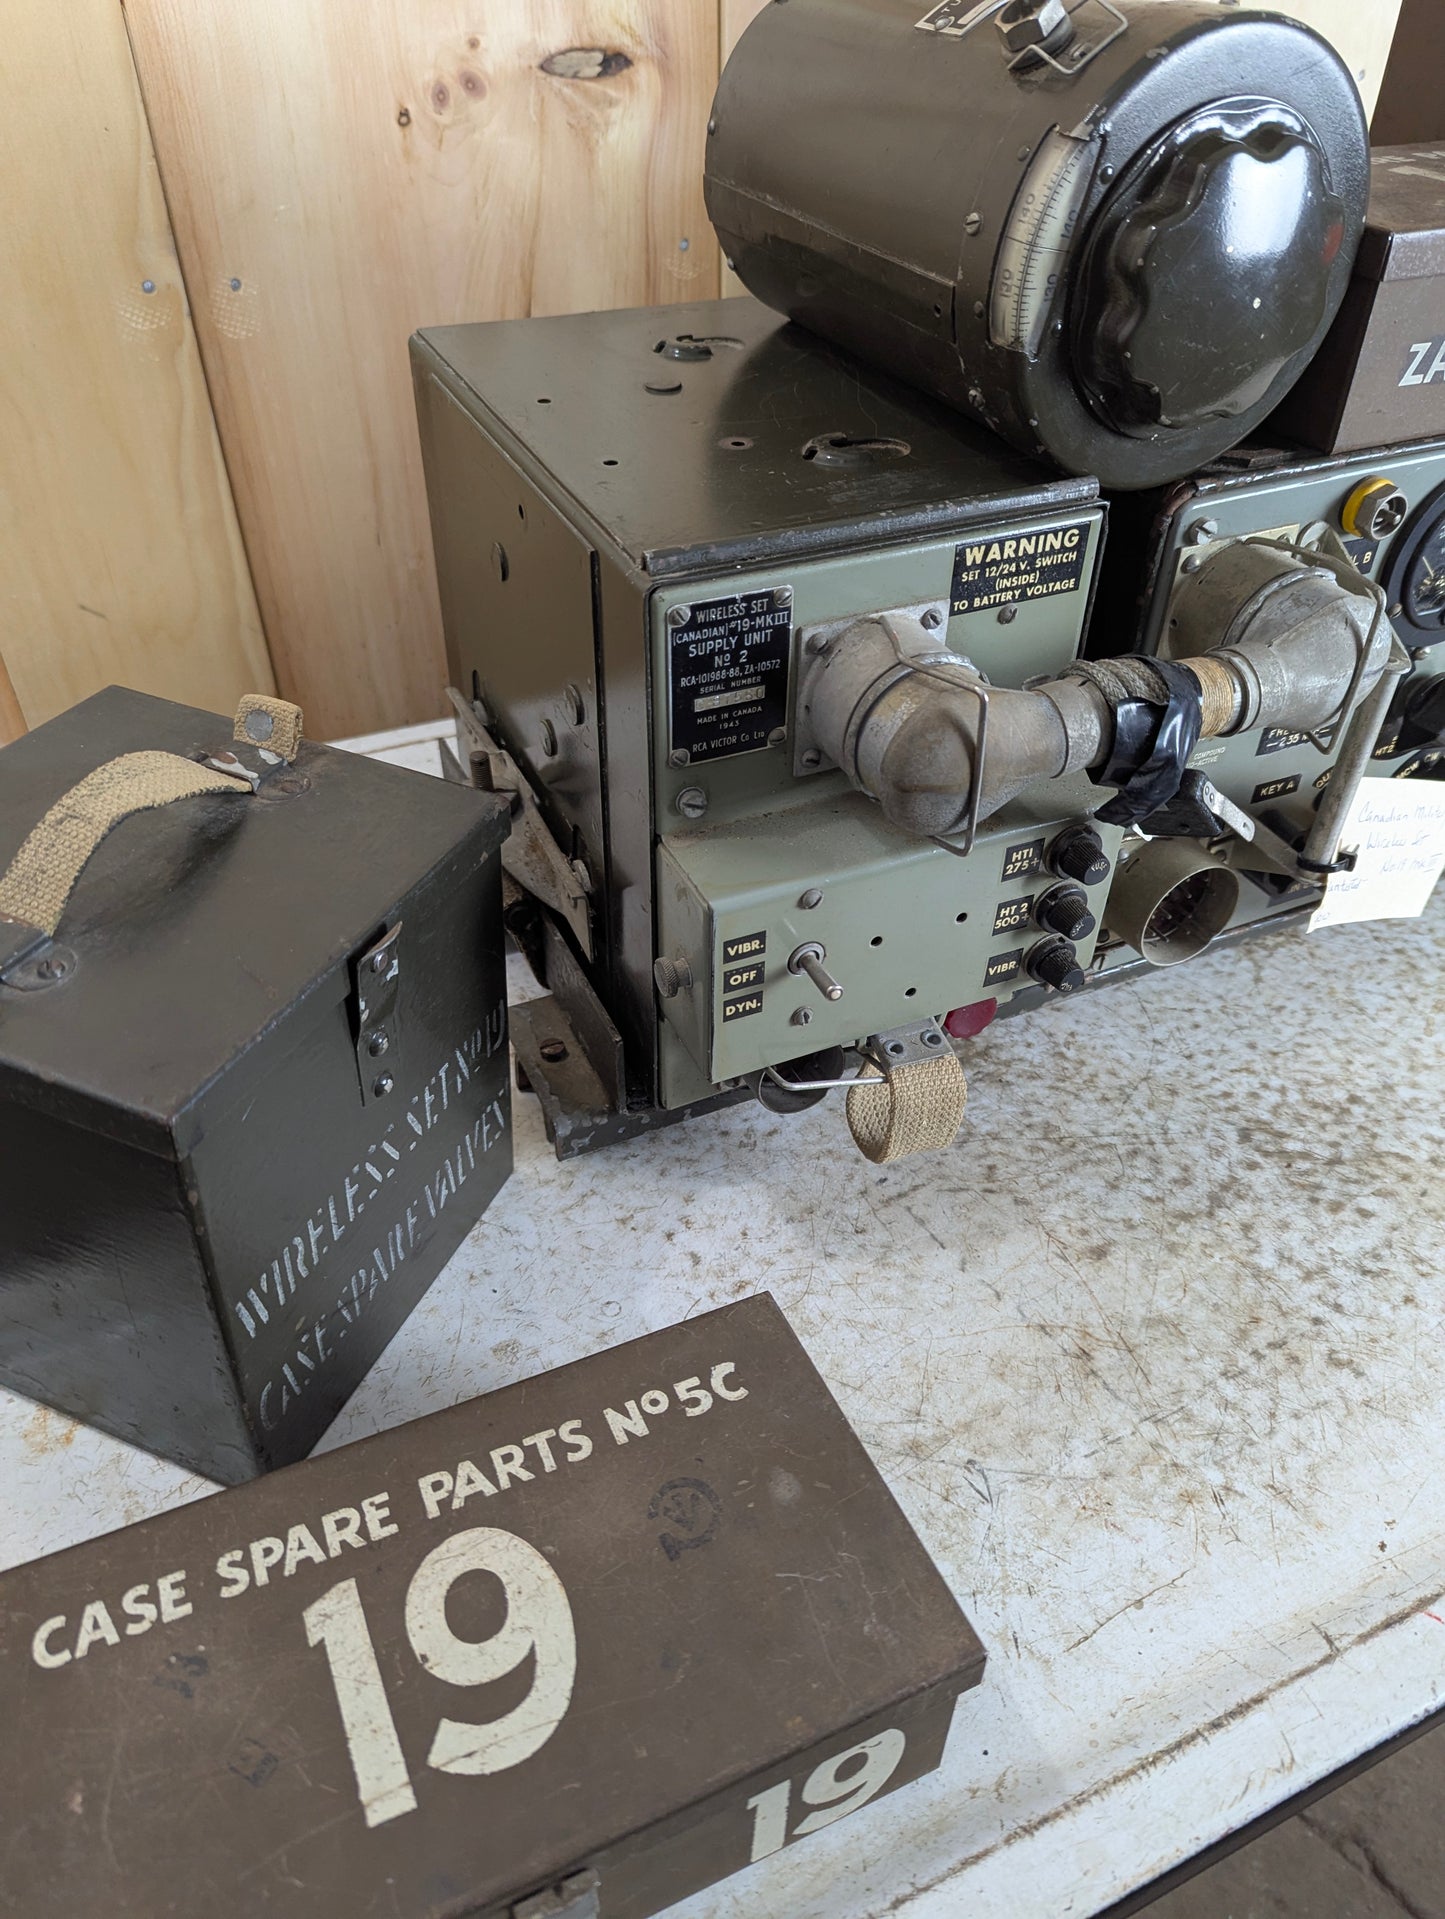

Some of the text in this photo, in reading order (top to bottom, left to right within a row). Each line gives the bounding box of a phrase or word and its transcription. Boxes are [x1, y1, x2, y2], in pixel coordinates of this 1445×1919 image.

[965, 528, 1080, 567] WARNING
[1362, 551, 1372, 564] B
[961, 569, 980, 582] SET
[985, 562, 1016, 578] 12/24
[1035, 552, 1077, 568] SWITCH
[995, 572, 1040, 590] (INSIDE)
[953, 578, 1076, 612] TO BATTERY VOLTAGE
[696, 598, 769, 624] WIRELESS SET
[673, 624, 729, 646] (CANADIAN)
[688, 629, 773, 658] SUPPLY UNIT
[739, 650, 748, 663] 2
[744, 659, 781, 675] ZA-10572
[700, 676, 762, 694] SERIAL NUMBER
[696, 706, 763, 726] MADE IN CANADA
[692, 740, 708, 752] RCA
[710, 735, 737, 748] VICTOR
[1260, 780, 1295, 797] KEY A
[727, 940, 764, 956] VIBR.
[729, 970, 758, 986] OFF
[988, 961, 1019, 976] VIBR.
[726, 999, 761, 1016] DYN.
[235, 1123, 400, 1338] WIRELESS
[406, 1062, 449, 1152] SET
[259, 1087, 506, 1431] CASE SPARE VALVES
[31, 1569, 194, 1670] CASE
[218, 1492, 400, 1600] SPARE
[416, 1419, 594, 1520] PARTS
[302, 1526, 578, 1829] 19
[747, 1727, 908, 1864] 19
